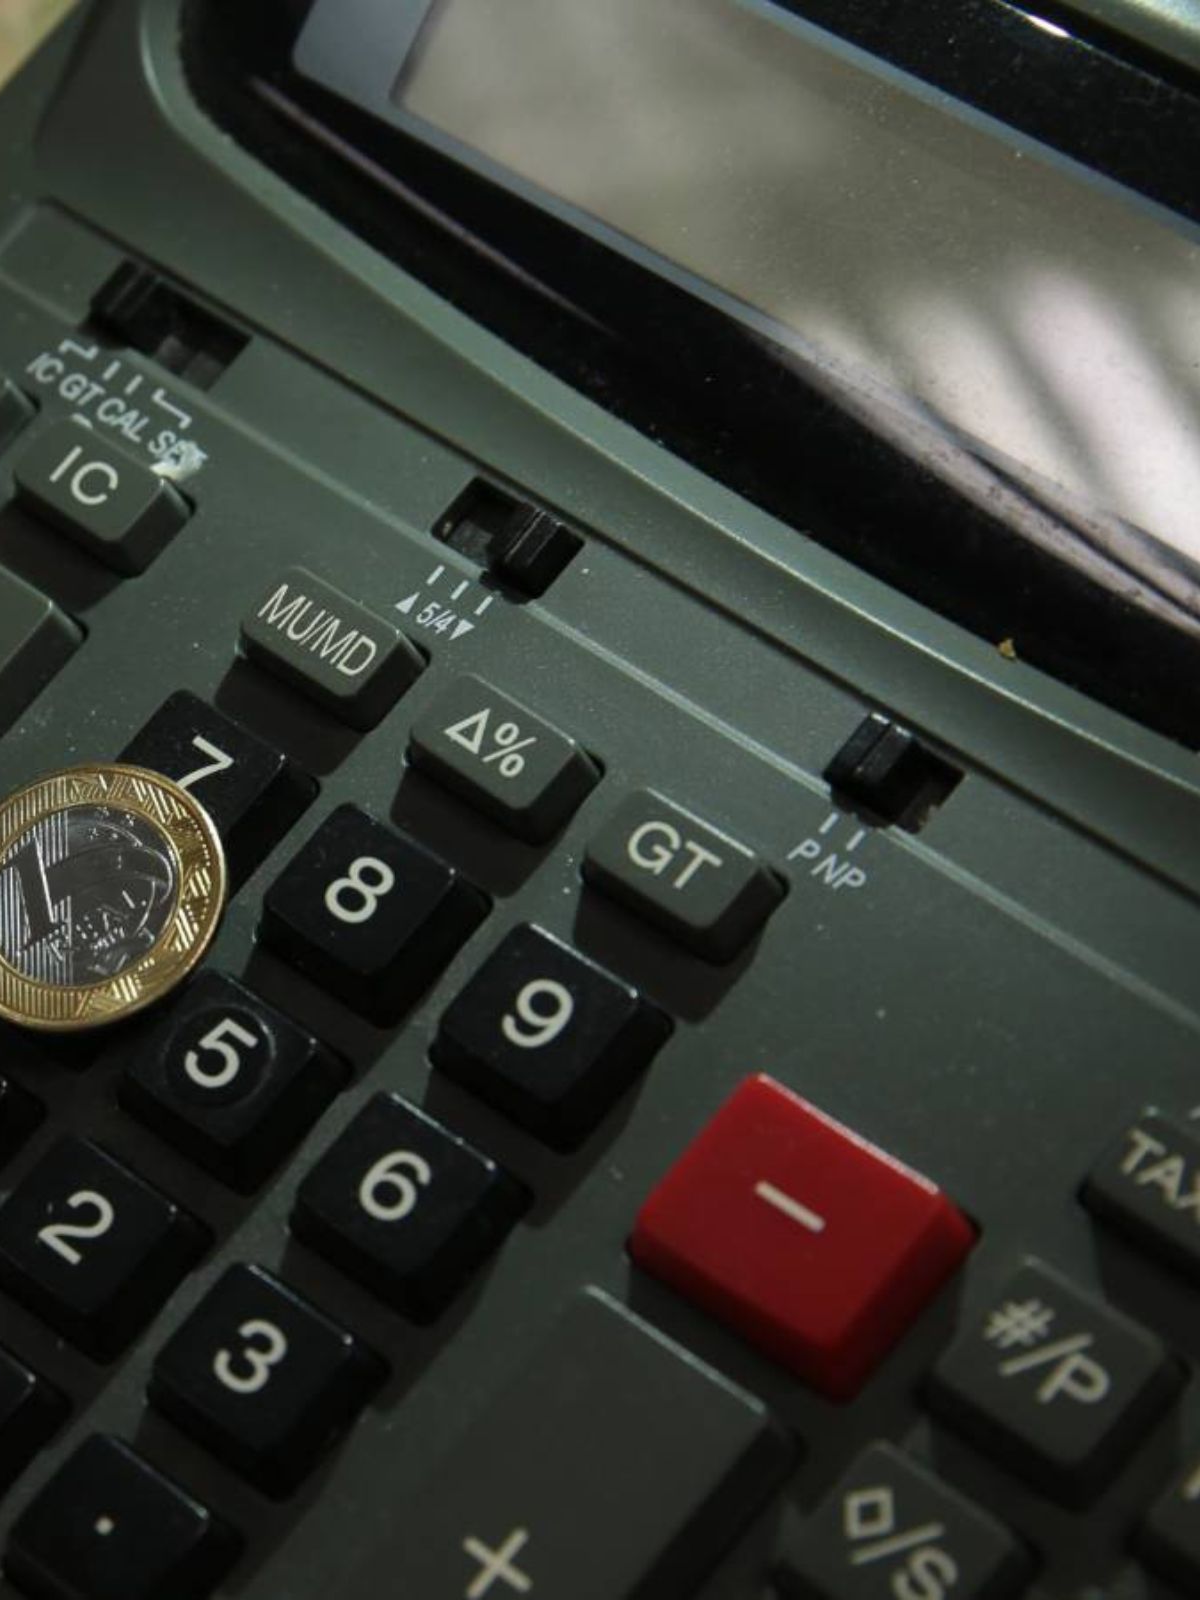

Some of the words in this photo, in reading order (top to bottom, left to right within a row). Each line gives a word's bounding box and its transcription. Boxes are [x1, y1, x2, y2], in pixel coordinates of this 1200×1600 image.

[58, 373, 107, 406] GT
[96, 397, 149, 443] CAL
[50, 447, 118, 504] IC
[257, 584, 378, 677] MU/MD
[177, 736, 234, 789] 7
[628, 821, 722, 889] GT
[810, 853, 868, 890] NP
[325, 857, 394, 922] 8
[503, 980, 573, 1047] 9
[185, 1019, 257, 1087] 5
[360, 1151, 430, 1220] 6
[38, 1191, 113, 1264] 2
[215, 1320, 286, 1392] 3
[984, 1298, 1110, 1403] #/P
